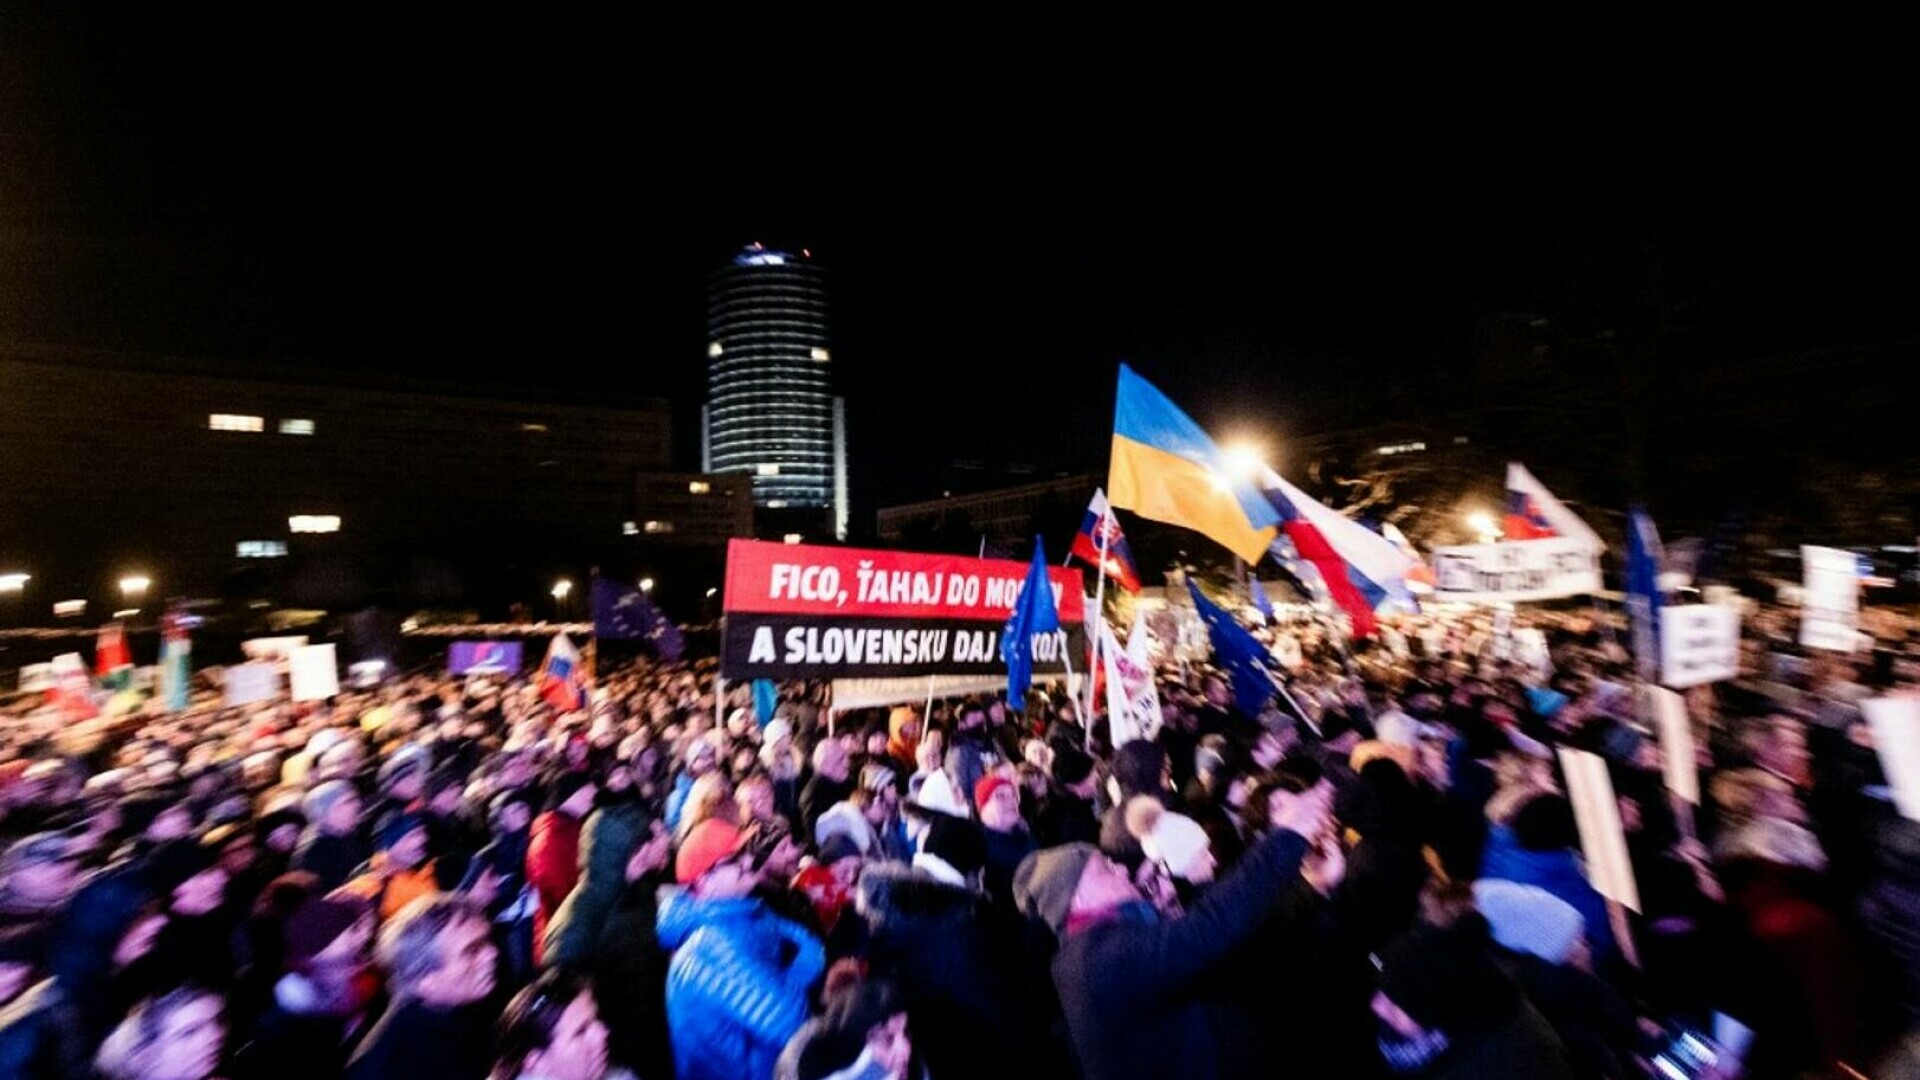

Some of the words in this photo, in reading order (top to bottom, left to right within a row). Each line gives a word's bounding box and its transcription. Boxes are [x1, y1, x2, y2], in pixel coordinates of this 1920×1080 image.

[769, 563, 849, 608] FICO,
[857, 559, 943, 605] ŤAHAJ
[947, 573, 980, 607] DO
[748, 625, 776, 663] A
[784, 626, 948, 664] SLOVENSKU
[953, 630, 997, 663] DAJ
